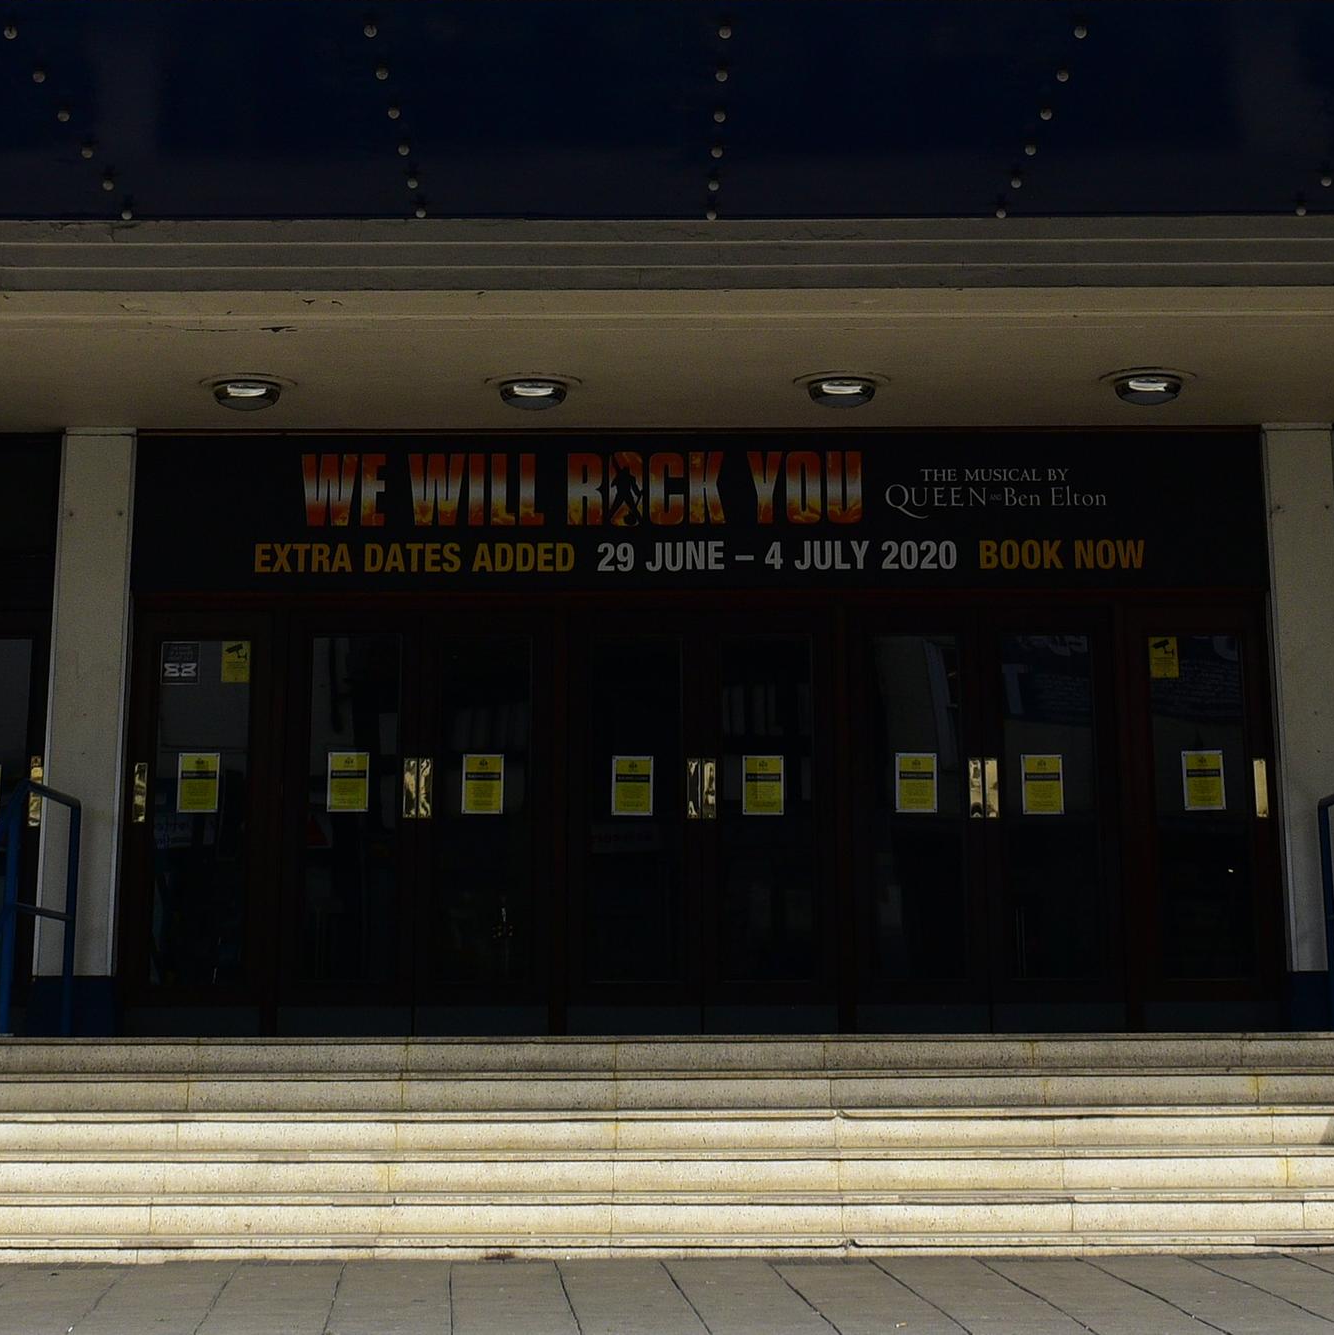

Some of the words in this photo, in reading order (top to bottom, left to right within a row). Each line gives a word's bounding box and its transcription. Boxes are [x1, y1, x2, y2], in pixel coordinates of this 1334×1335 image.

[300, 451, 388, 527] WE
[407, 451, 547, 527] WILL
[566, 450, 728, 527] ROCK
[746, 449, 865, 526] YOU
[919, 468, 958, 482] THE
[965, 468, 1042, 482] MUSICAL
[1047, 468, 1070, 482] BY
[883, 483, 988, 520] QUEEN
[1004, 486, 1042, 506] Ben
[1051, 485, 1108, 507] Elton
[253, 542, 353, 573] EXTRA
[364, 541, 461, 573] DATES
[471, 541, 576, 573] ADDED
[596, 541, 636, 572] 29
[645, 540, 725, 572] JUNE
[764, 541, 783, 570] 4
[794, 540, 870, 570] JULY
[880, 539, 958, 570] 2020
[978, 538, 1065, 570] BOOK
[1073, 538, 1146, 570] NOW
